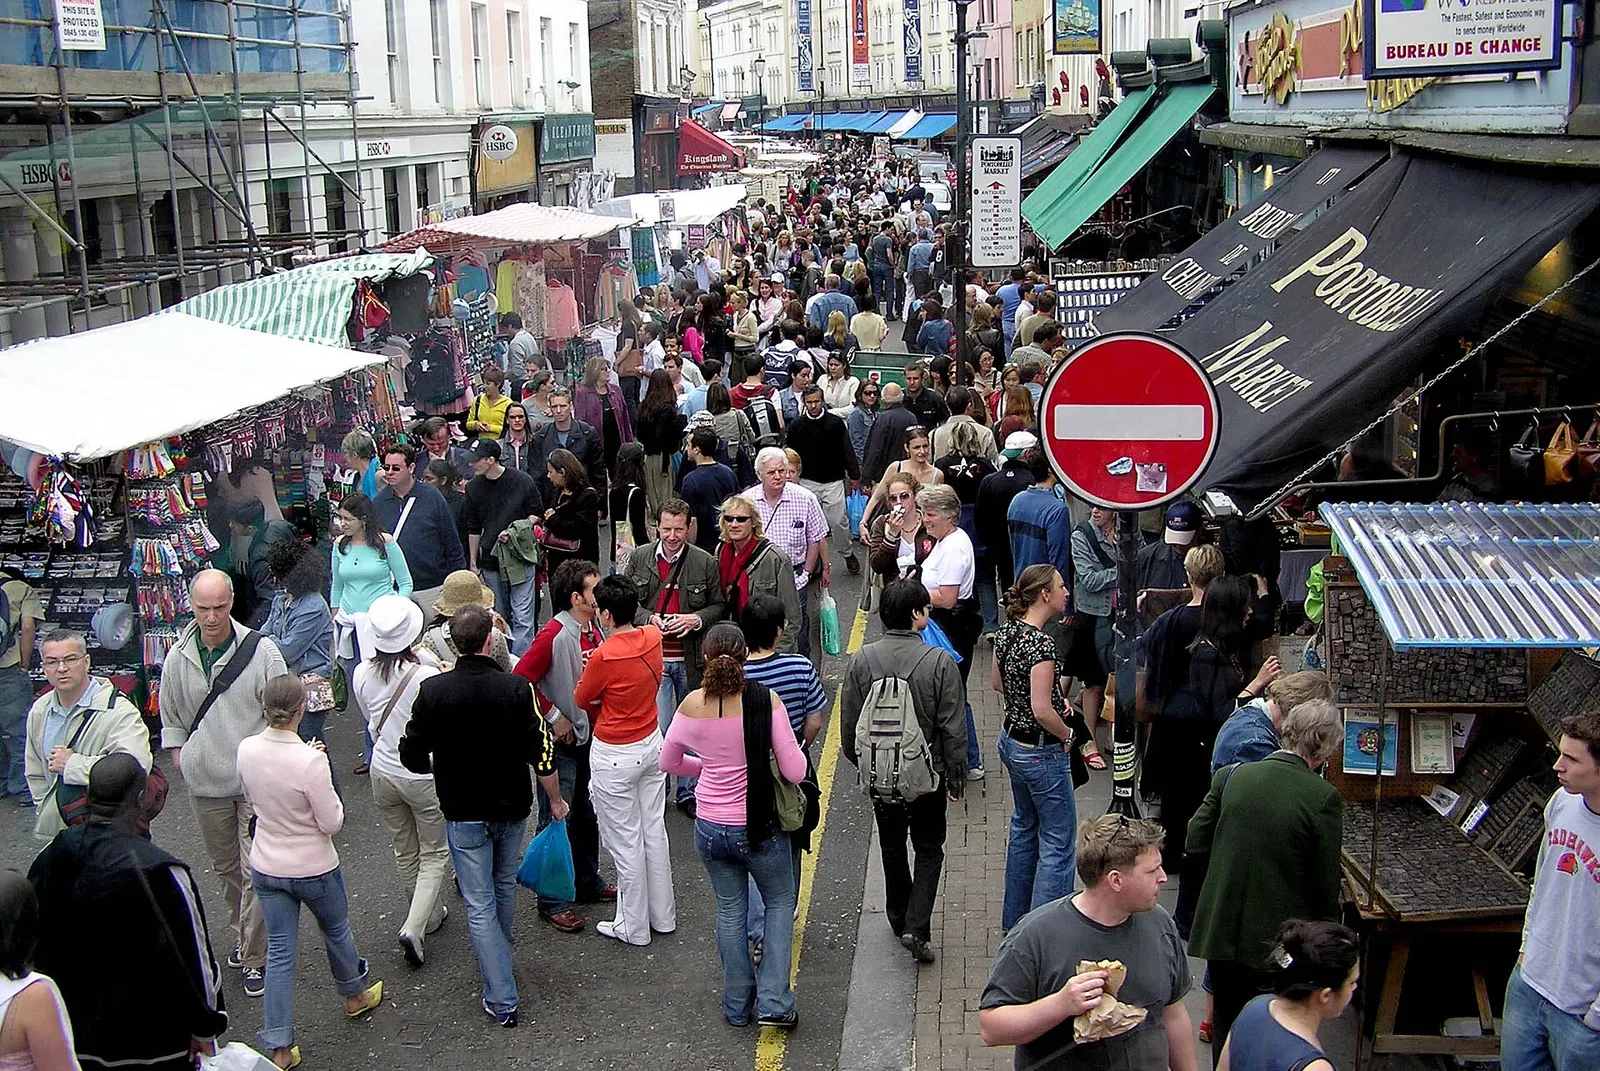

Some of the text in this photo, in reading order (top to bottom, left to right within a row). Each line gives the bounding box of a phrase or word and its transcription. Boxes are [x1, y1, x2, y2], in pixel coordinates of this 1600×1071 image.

[62, 6, 76, 14] THIS
[78, 7, 90, 15] SITE
[1442, 14, 1450, 22] The
[1475, 11, 1492, 21] Safest
[1494, 11, 1504, 20] and
[1506, 8, 1533, 18] Economic
[62, 17, 98, 27] PROTECTED
[1456, 24, 1526, 36] to send money Worldwide
[1386, 38, 1541, 60] BUREAU DE CHANGE
[486, 142, 514, 151] HSBC
[683, 154, 728, 164] Kingsland
[936, 250, 943, 262] 8
[1219, 244, 1249, 266] DE
[1270, 226, 1445, 332] PORTOBELL
[1200, 320, 1314, 413] MARKET
